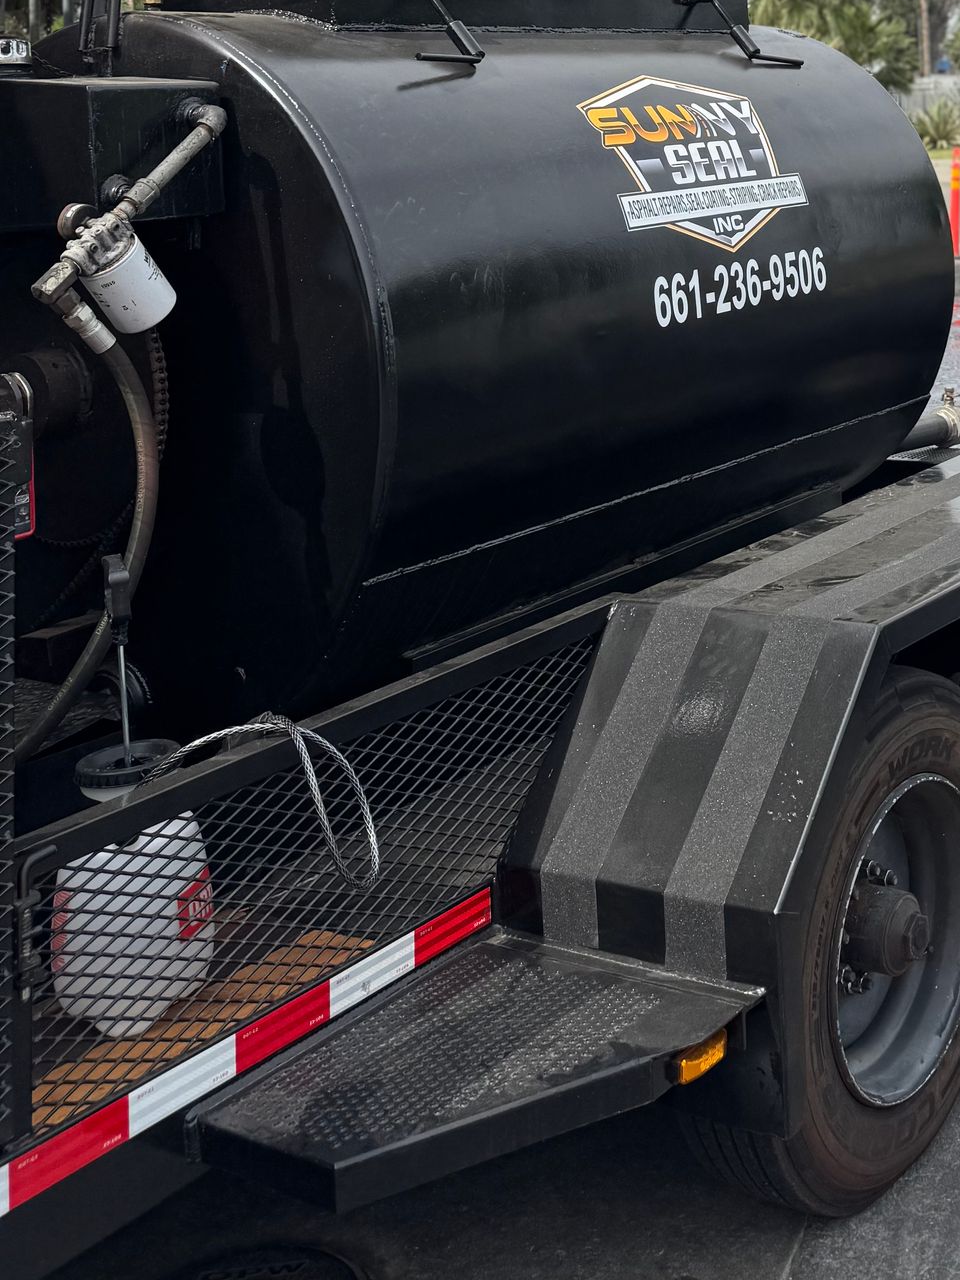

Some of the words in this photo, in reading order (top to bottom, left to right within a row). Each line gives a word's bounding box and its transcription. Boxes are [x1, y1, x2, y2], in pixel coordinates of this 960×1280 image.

[586, 100, 759, 146] SUNNY
[663, 139, 757, 185] SEAL
[712, 214, 745, 234] INC
[653, 246, 827, 328] 661-236-9506
